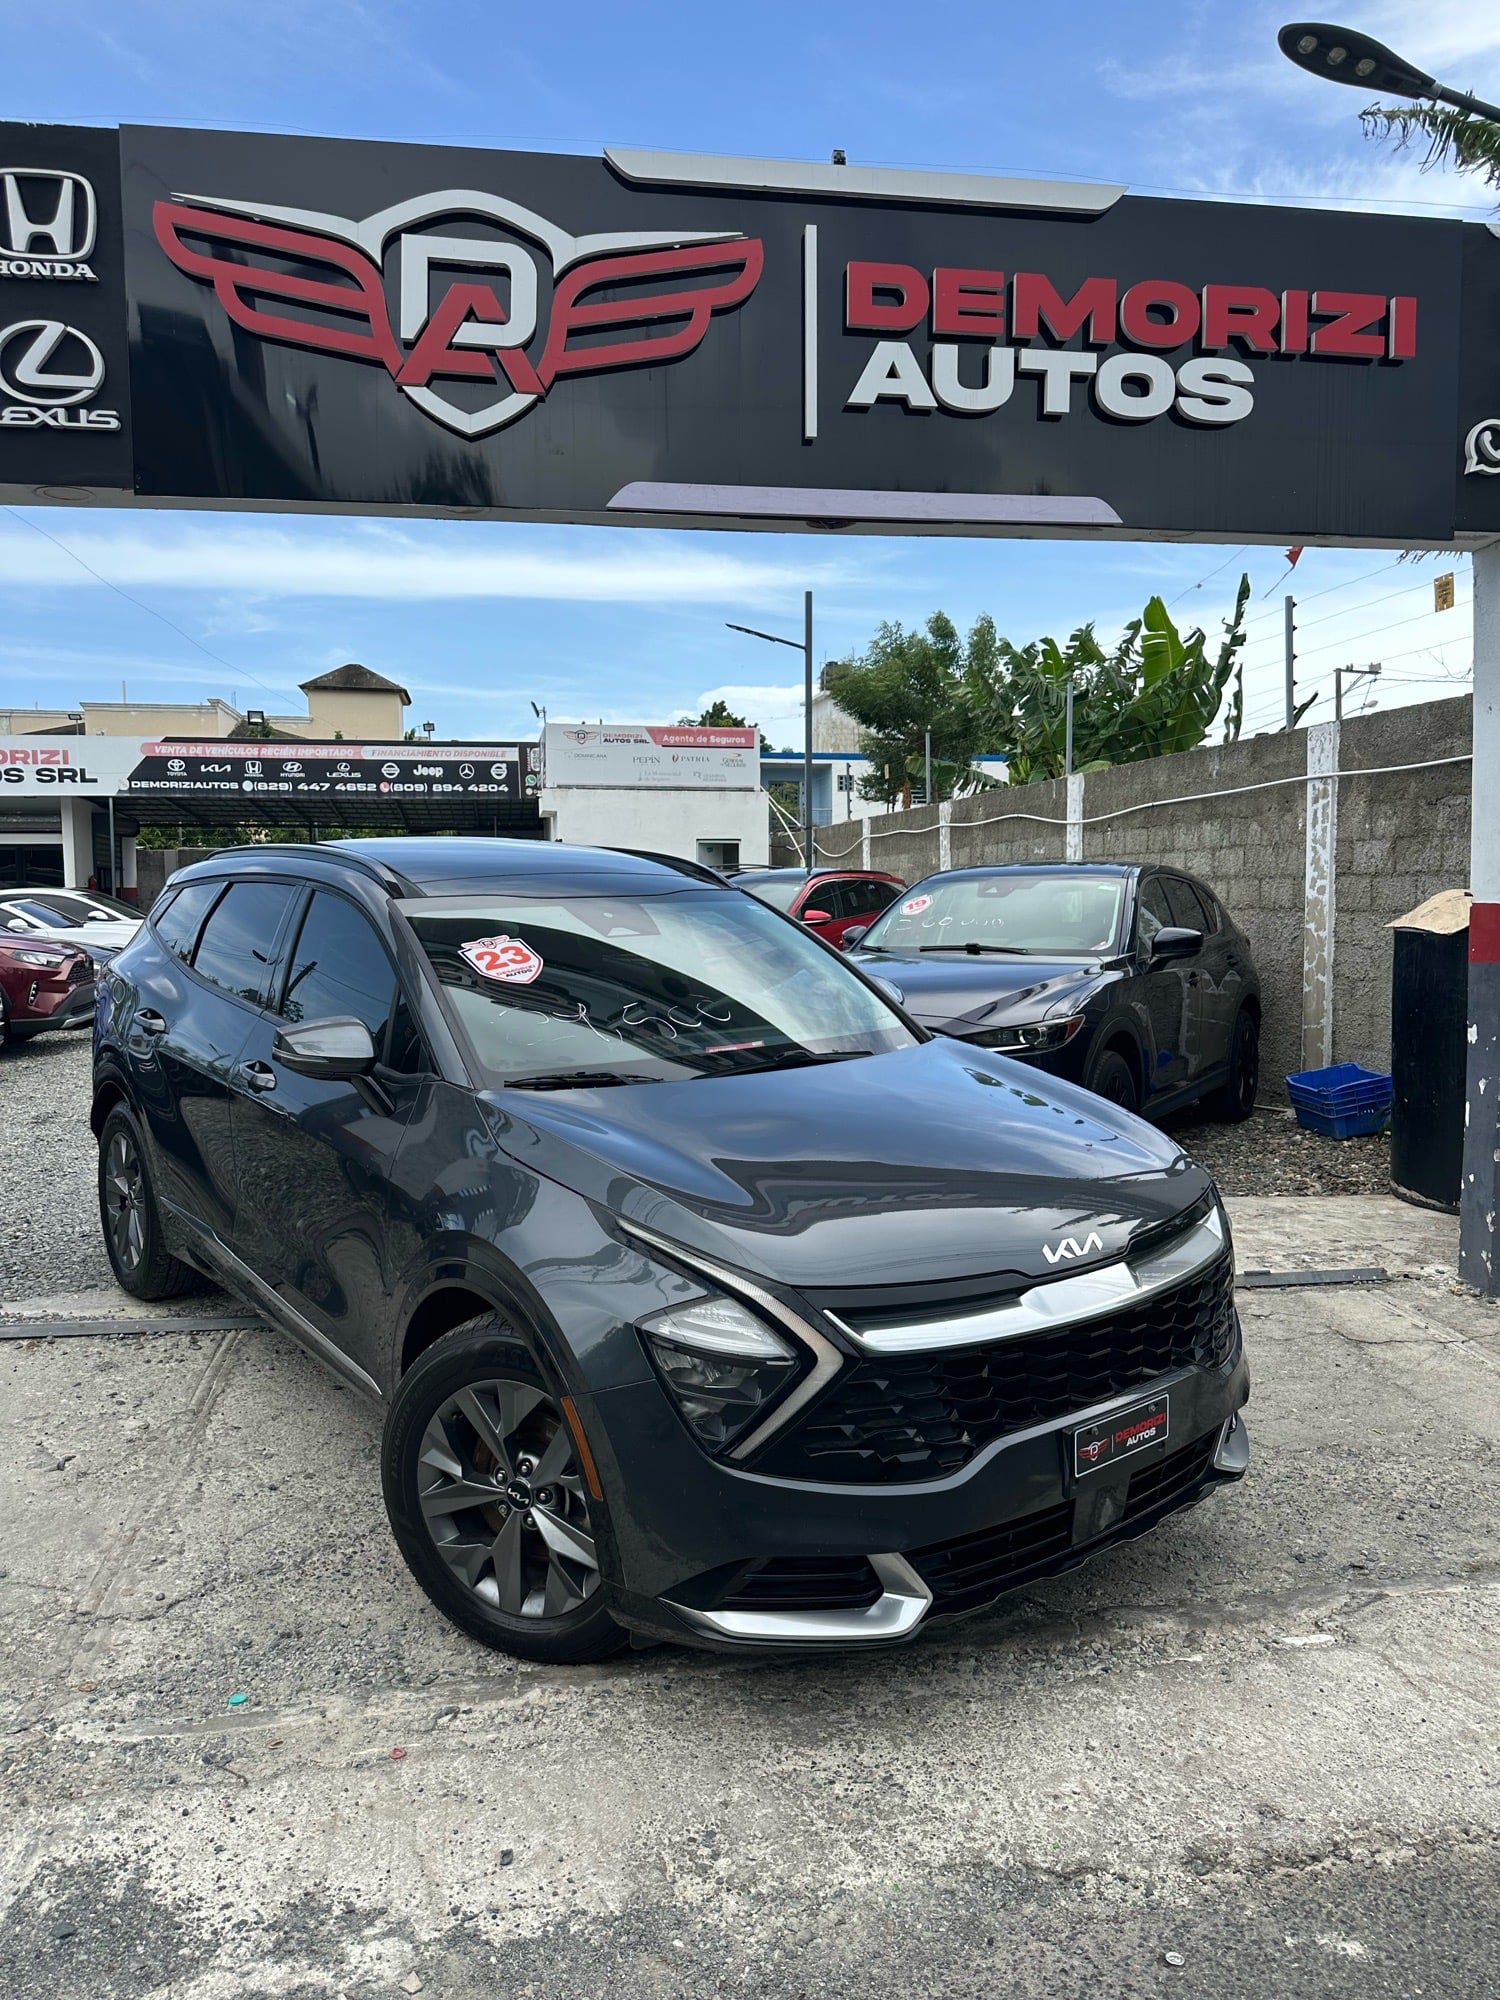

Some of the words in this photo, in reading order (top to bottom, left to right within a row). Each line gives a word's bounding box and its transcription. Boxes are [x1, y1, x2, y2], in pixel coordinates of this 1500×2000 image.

[846, 260, 1417, 359] DEMORIZI
[846, 340, 1256, 425] AUTOS
[0, 406, 120, 430] EXUS
[662, 734, 695, 743] Agente
[696, 735, 708, 743] de
[709, 735, 746, 744] Seguros
[154, 745, 187, 754] VENTA
[189, 745, 203, 754] DE
[297, 747, 355, 757] IMPORTADO
[371, 748, 451, 758] FINANCIAMIENTO
[453, 749, 507, 758] DISPONIBLE
[35, 767, 98, 783] SRL
[413, 764, 444, 778] Jeep
[131, 780, 239, 790] DEMORIZIAUTOS
[254, 781, 293, 791] (829)
[297, 782, 331, 791] 447
[390, 783, 428, 793] (809)
[432, 784, 464, 792] 894
[467, 784, 509, 792] 4204
[906, 899, 927, 910] 19
[475, 945, 532, 971] 23
[1115, 1412, 1167, 1442] DEMORIZI
[1126, 1427, 1157, 1447] AUTOS
